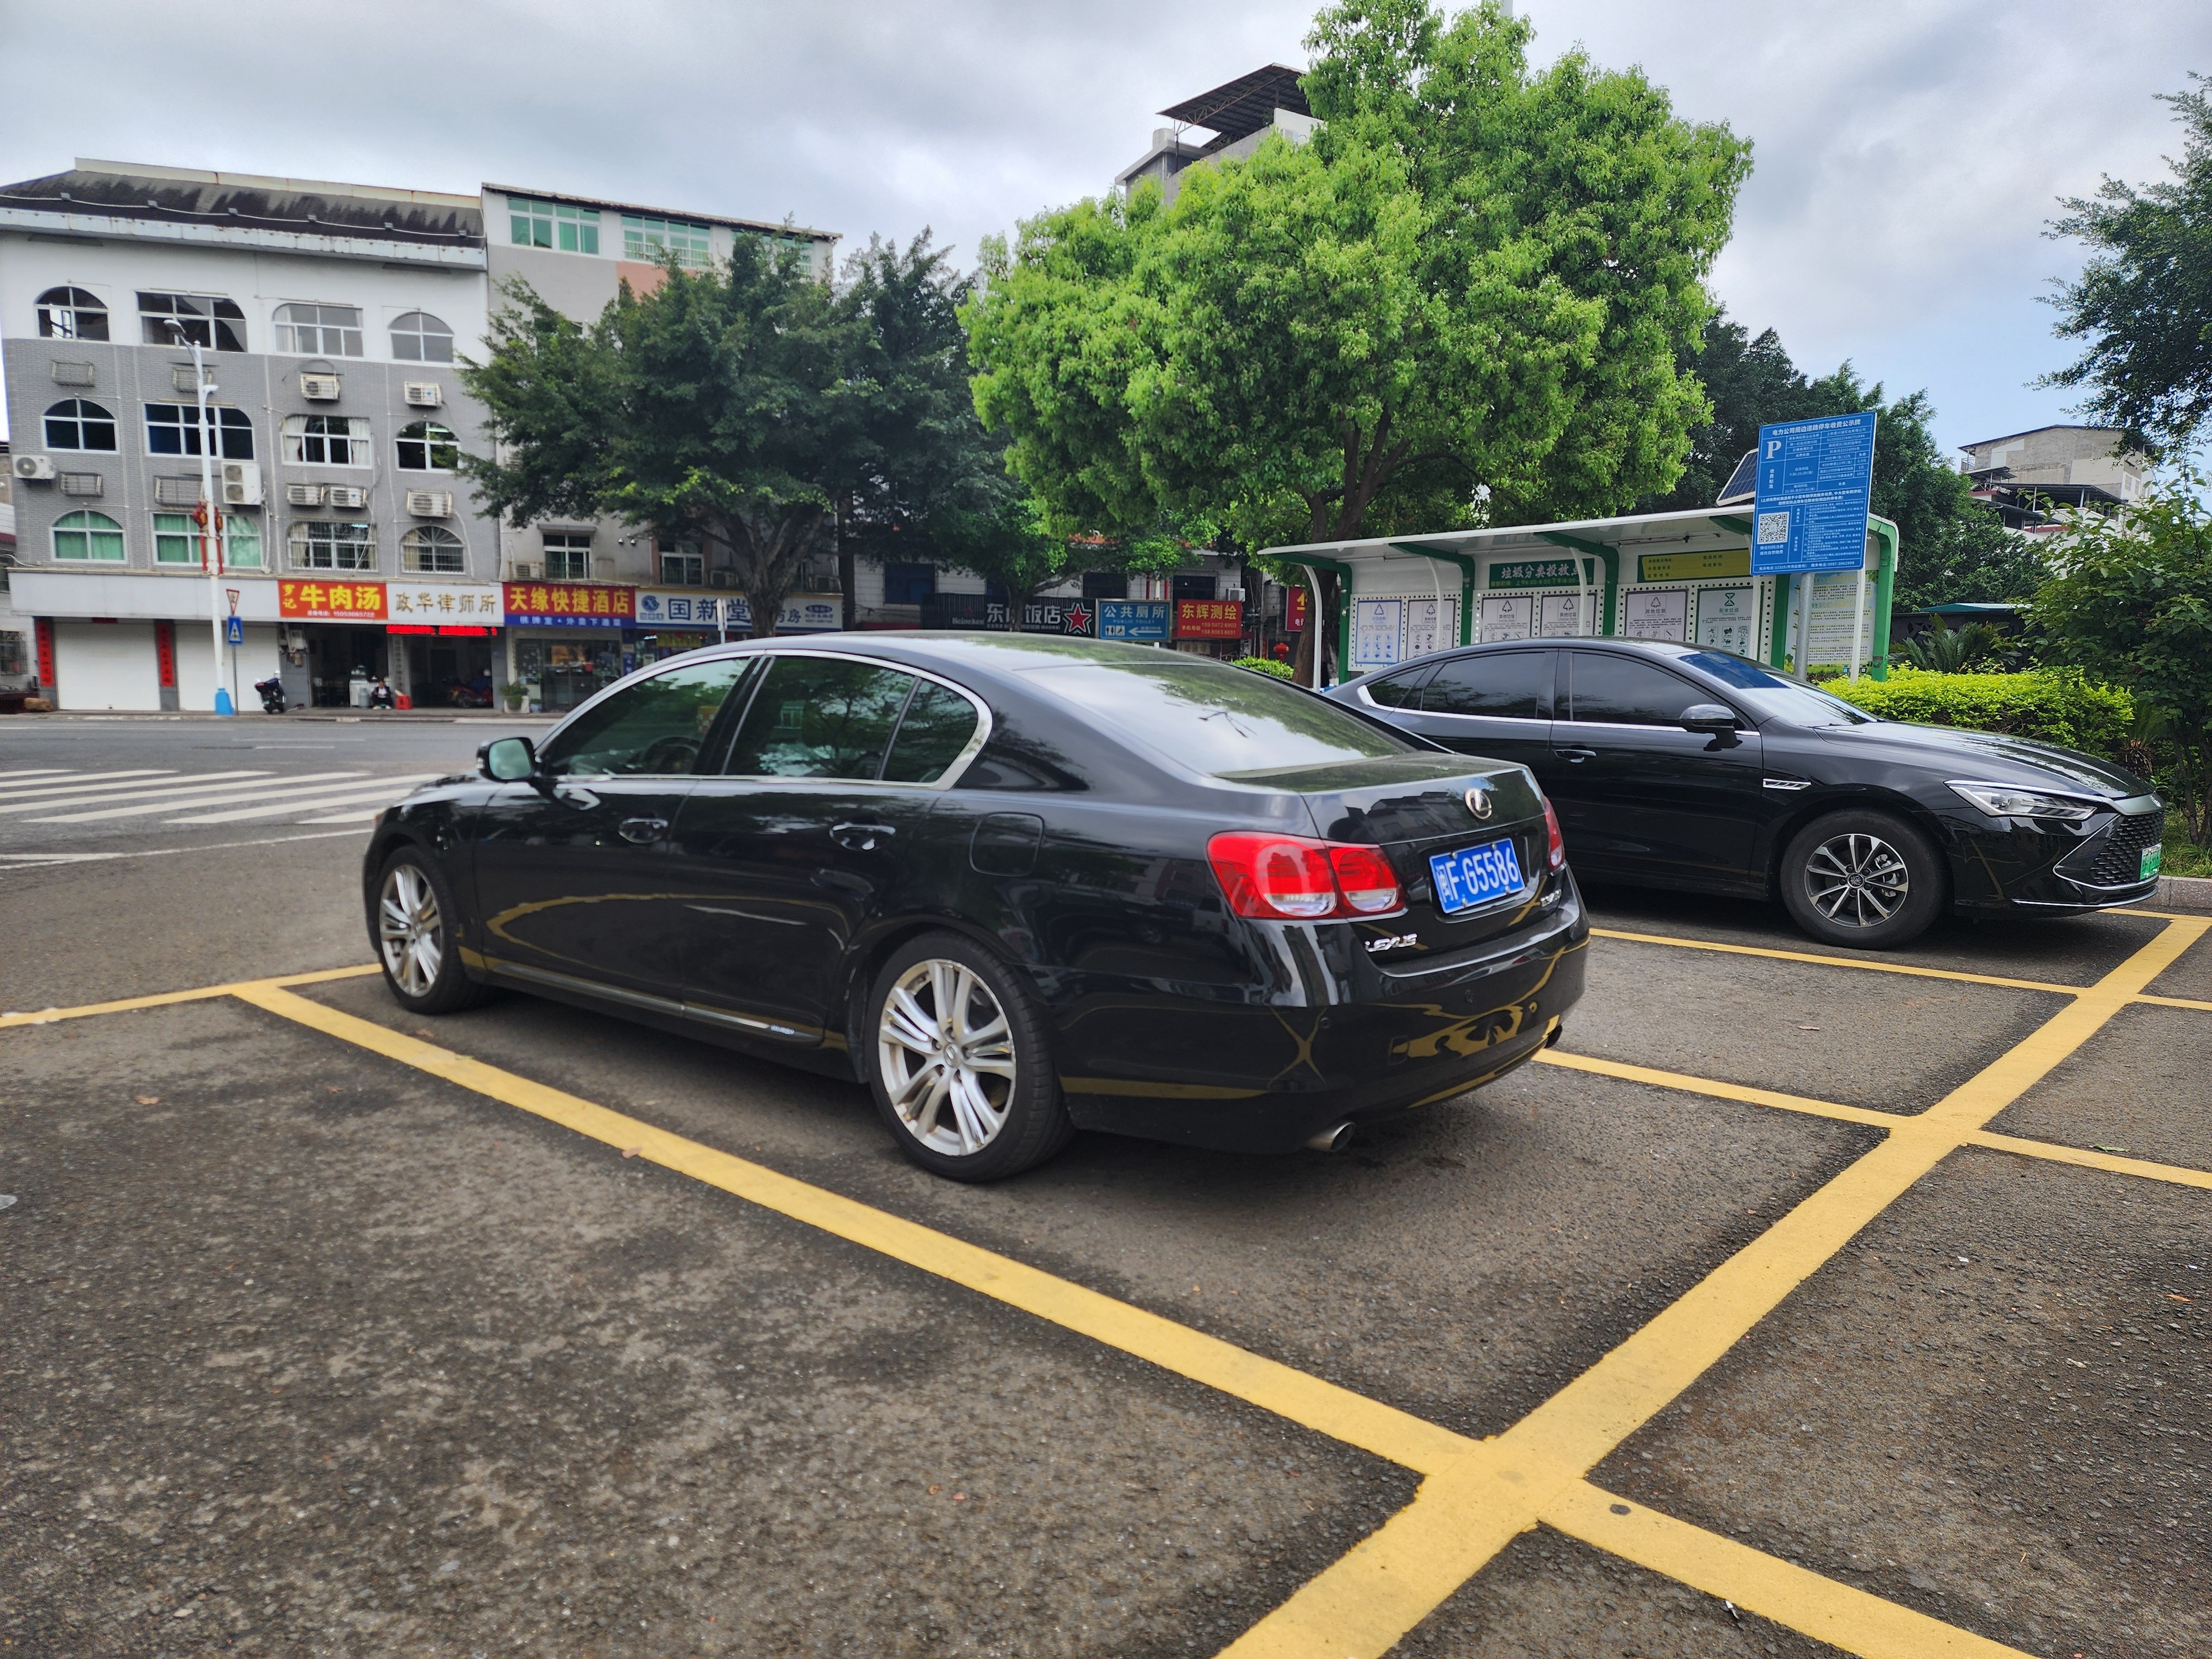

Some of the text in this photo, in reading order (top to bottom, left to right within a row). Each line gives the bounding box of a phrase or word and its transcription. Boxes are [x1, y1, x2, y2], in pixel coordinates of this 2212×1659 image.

[1772, 419, 1861, 436] 电力公司周边道路停车收费公示牌
[1765, 441, 1782, 460] P
[300, 585, 380, 610] 牛肉汤
[395, 592, 496, 615] 政华律师所
[510, 587, 629, 614] 天缘快捷酒店
[1104, 606, 1165, 619] 公共厕所
[1182, 604, 1237, 620] 东辉测绘
